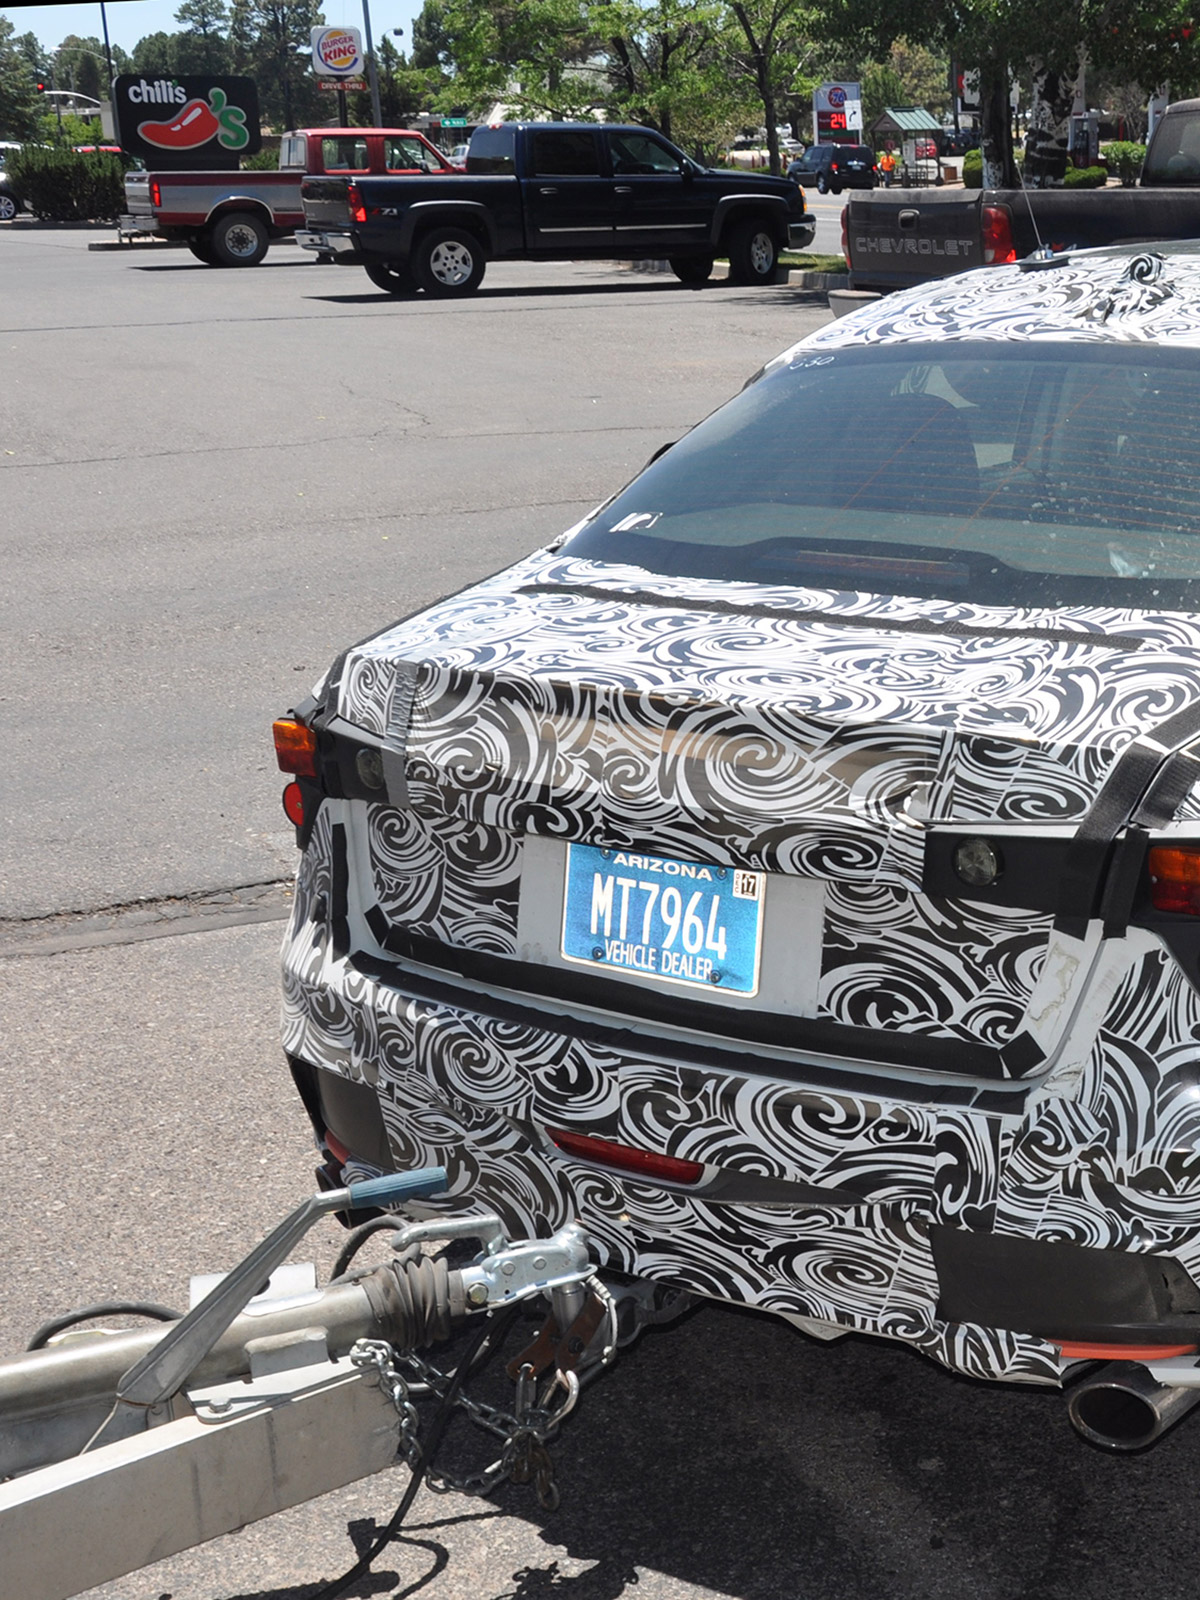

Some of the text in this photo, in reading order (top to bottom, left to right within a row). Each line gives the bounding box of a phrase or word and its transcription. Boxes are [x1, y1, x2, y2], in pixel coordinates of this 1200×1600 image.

[321, 36, 353, 50] BURGER
[323, 44, 356, 62] KING
[832, 91, 845, 103] 76
[855, 236, 973, 256] CHEVROLET
[613, 852, 713, 882] ARIZONA
[742, 875, 756, 893] 17
[590, 872, 728, 960] MT7964
[604, 938, 713, 981] VEHICLE DEALER
